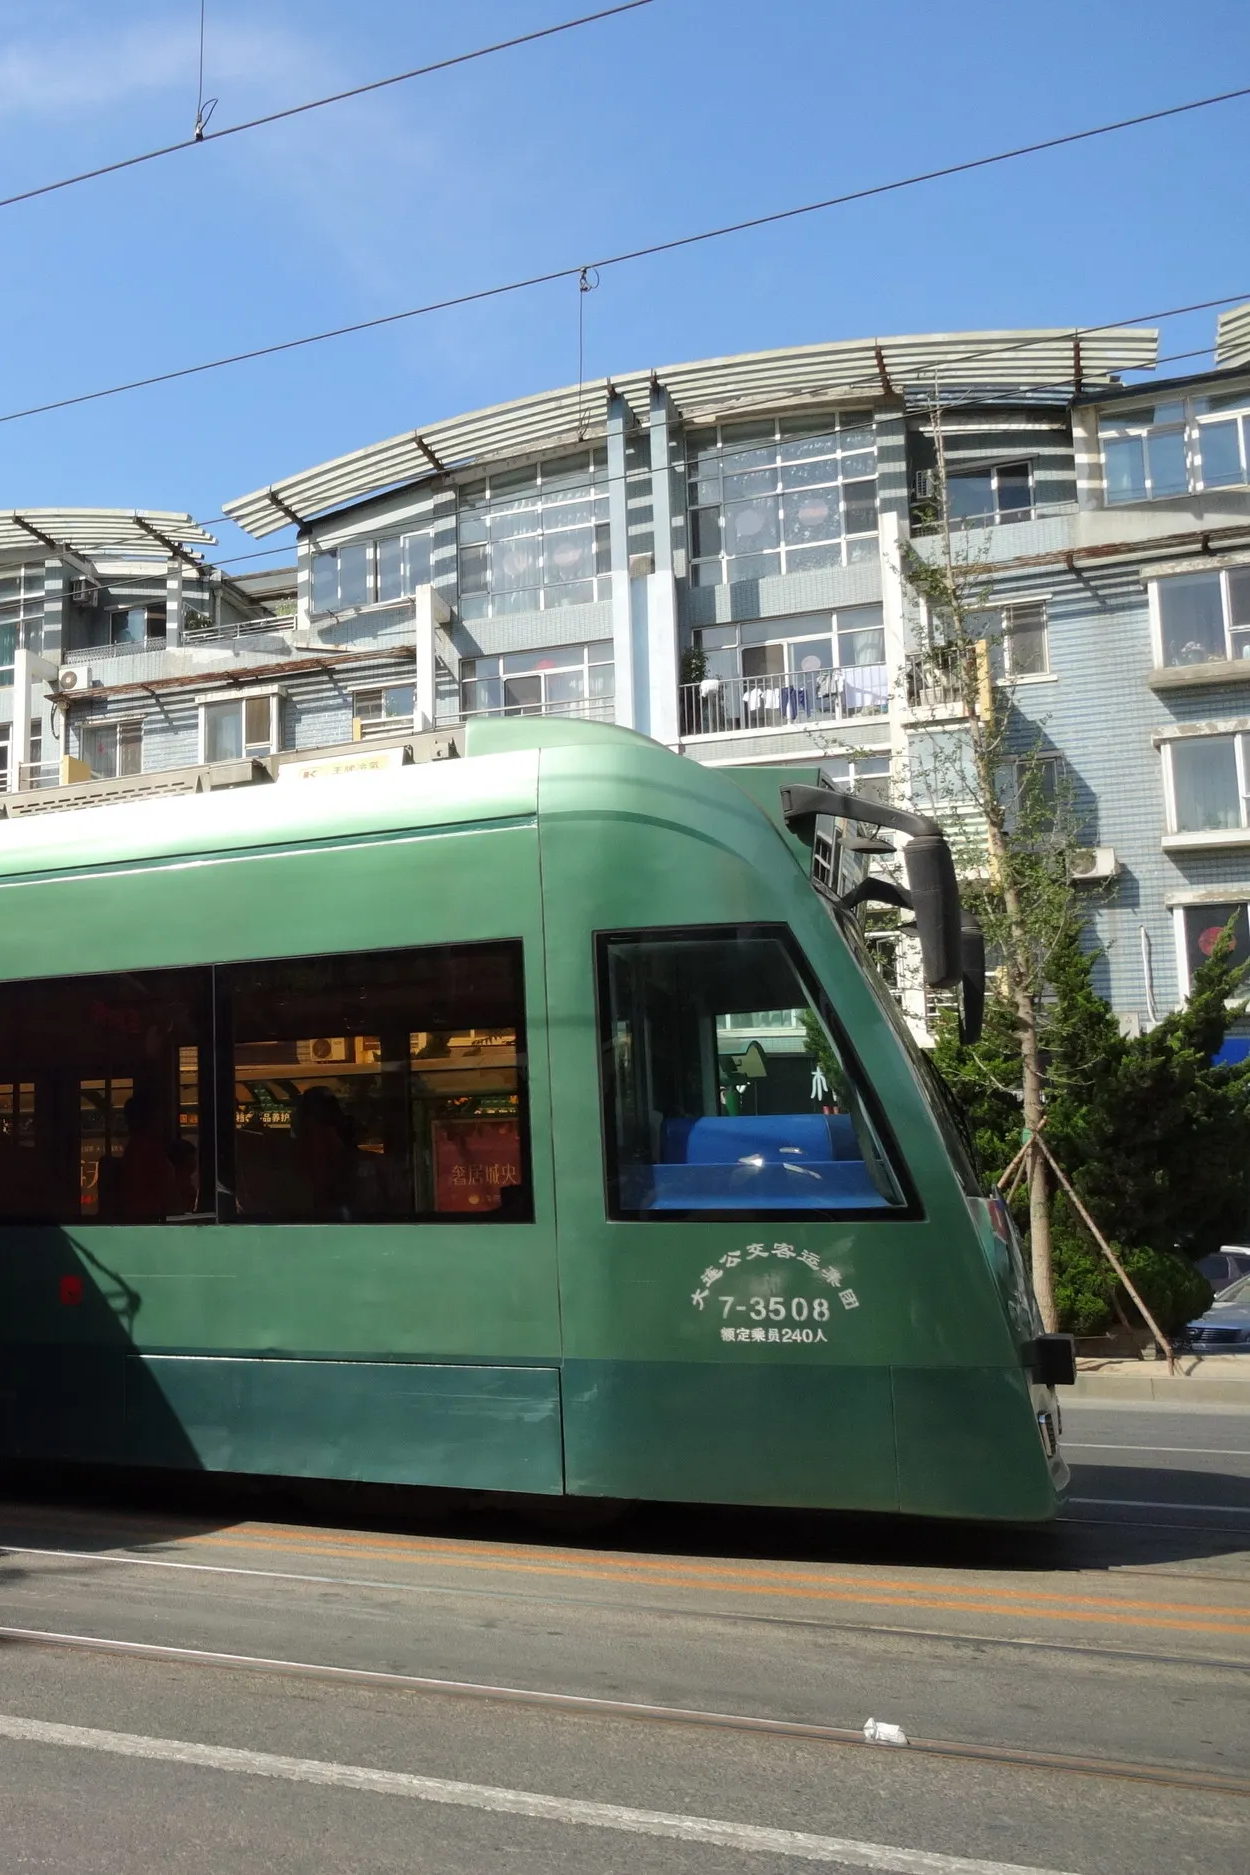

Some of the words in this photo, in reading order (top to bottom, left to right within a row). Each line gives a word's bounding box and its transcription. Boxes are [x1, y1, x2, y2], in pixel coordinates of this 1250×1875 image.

[690, 1242, 860, 1311] 大连公交客运集团
[718, 1296, 830, 1322] 7-3508
[720, 1326, 828, 1344] 额定乘员240人
